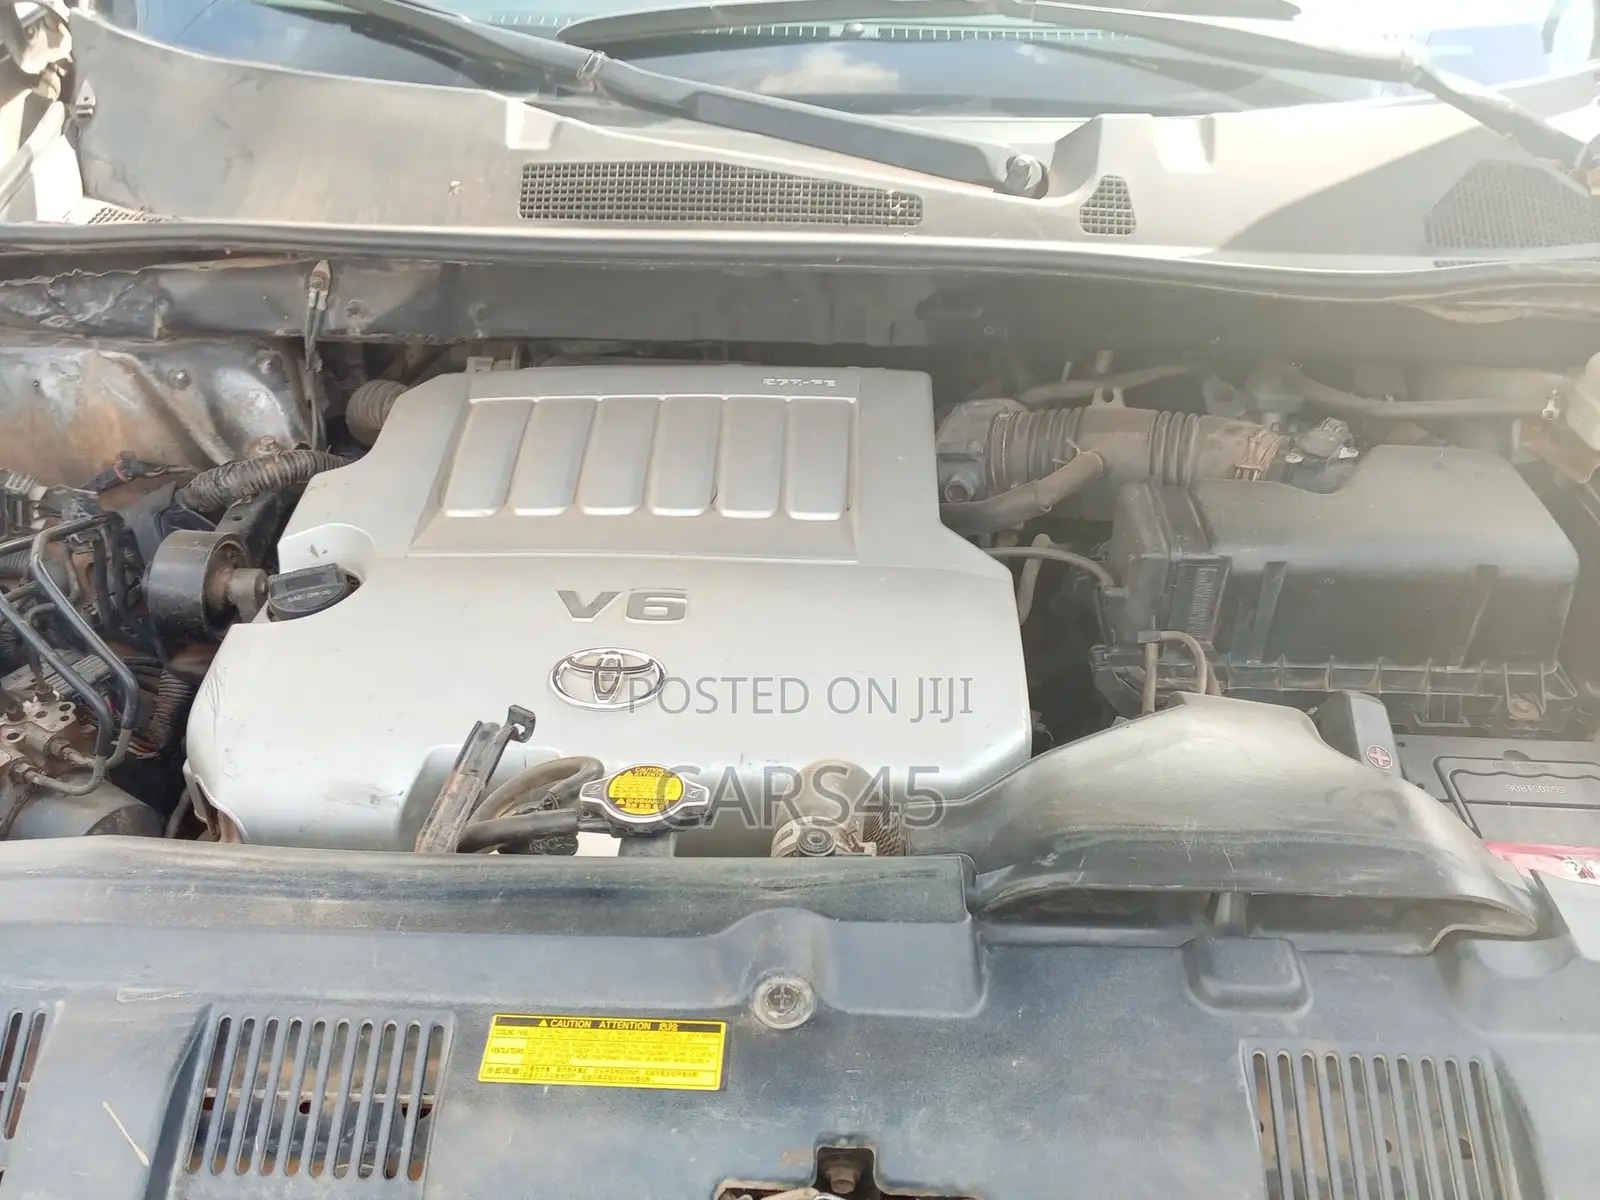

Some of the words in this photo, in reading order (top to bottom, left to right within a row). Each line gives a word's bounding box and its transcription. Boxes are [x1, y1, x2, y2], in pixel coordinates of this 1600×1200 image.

[555, 588, 688, 625] V6
[550, 1019, 592, 1028] CAUTION
[598, 1021, 651, 1030] ATTENTION
